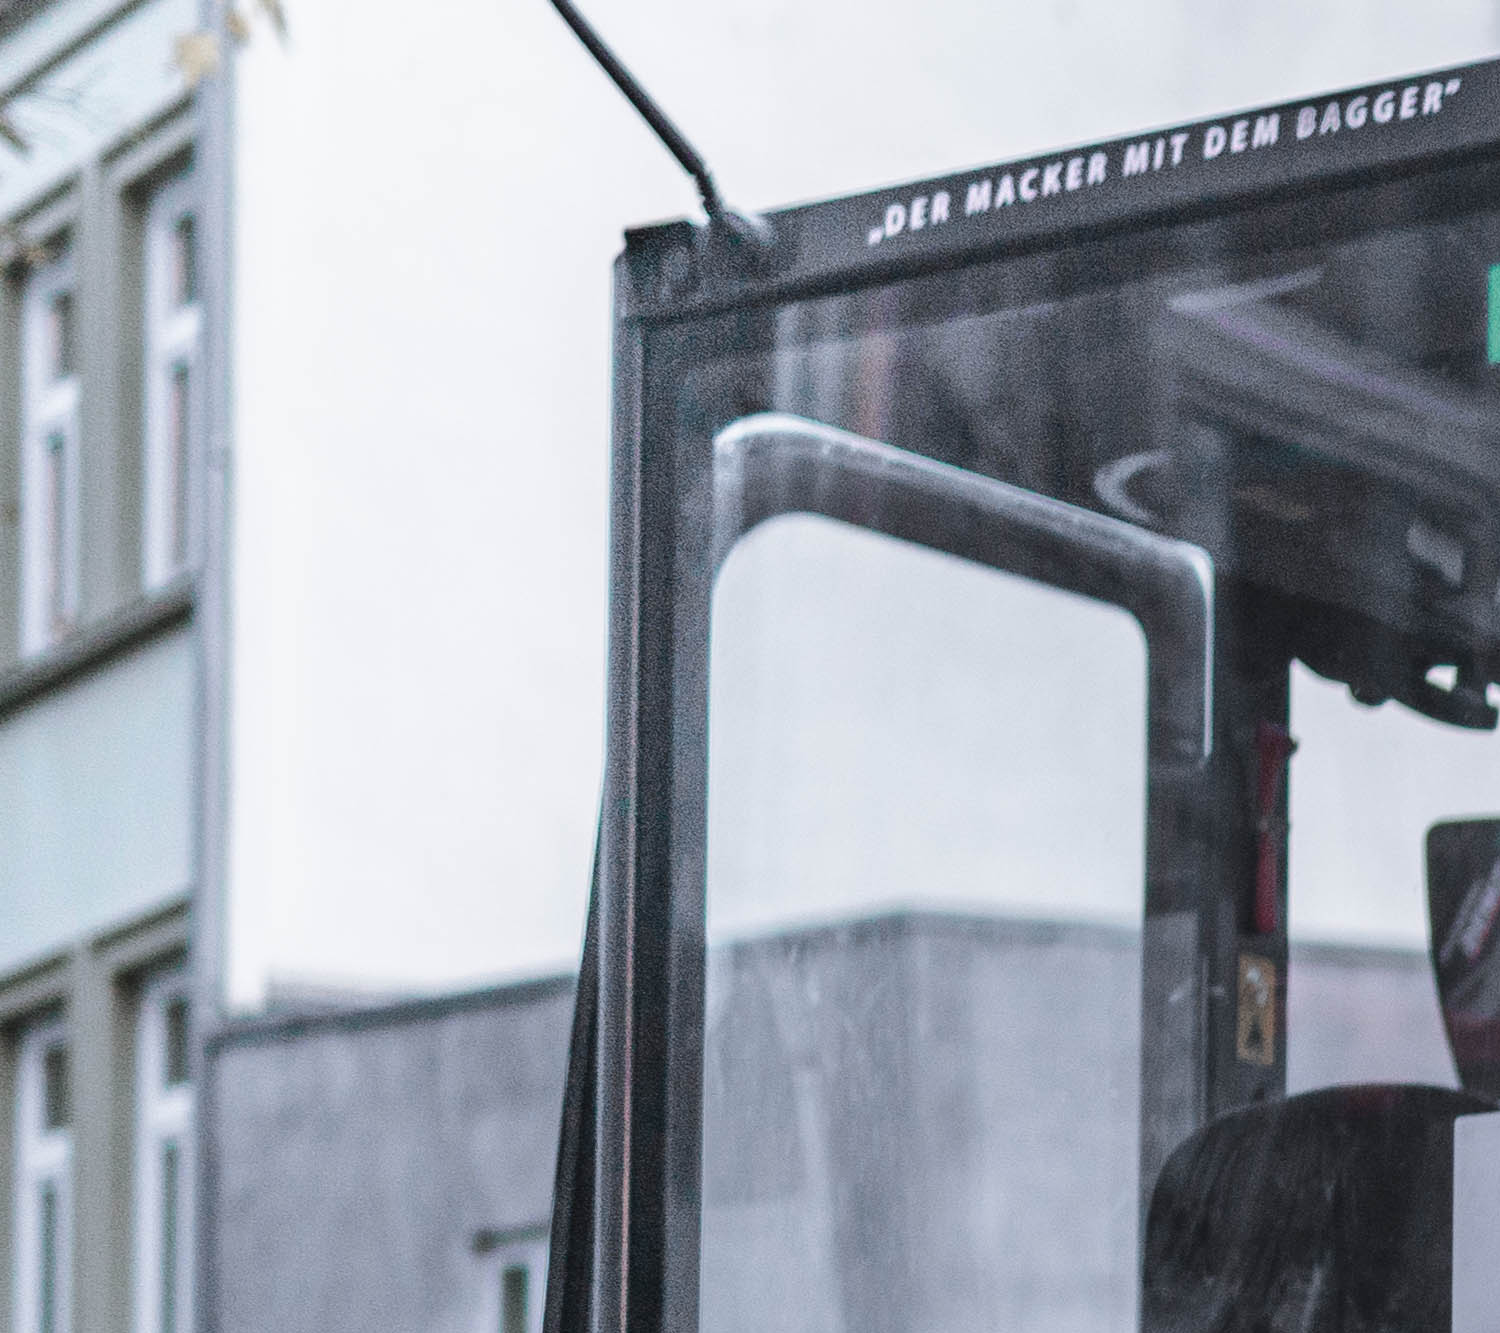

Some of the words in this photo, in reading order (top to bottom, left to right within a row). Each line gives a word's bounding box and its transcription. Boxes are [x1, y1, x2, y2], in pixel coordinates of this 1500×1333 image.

[965, 154, 1108, 216] MACKER
[1122, 133, 1189, 178] MIT
[1203, 115, 1280, 159] DEM
